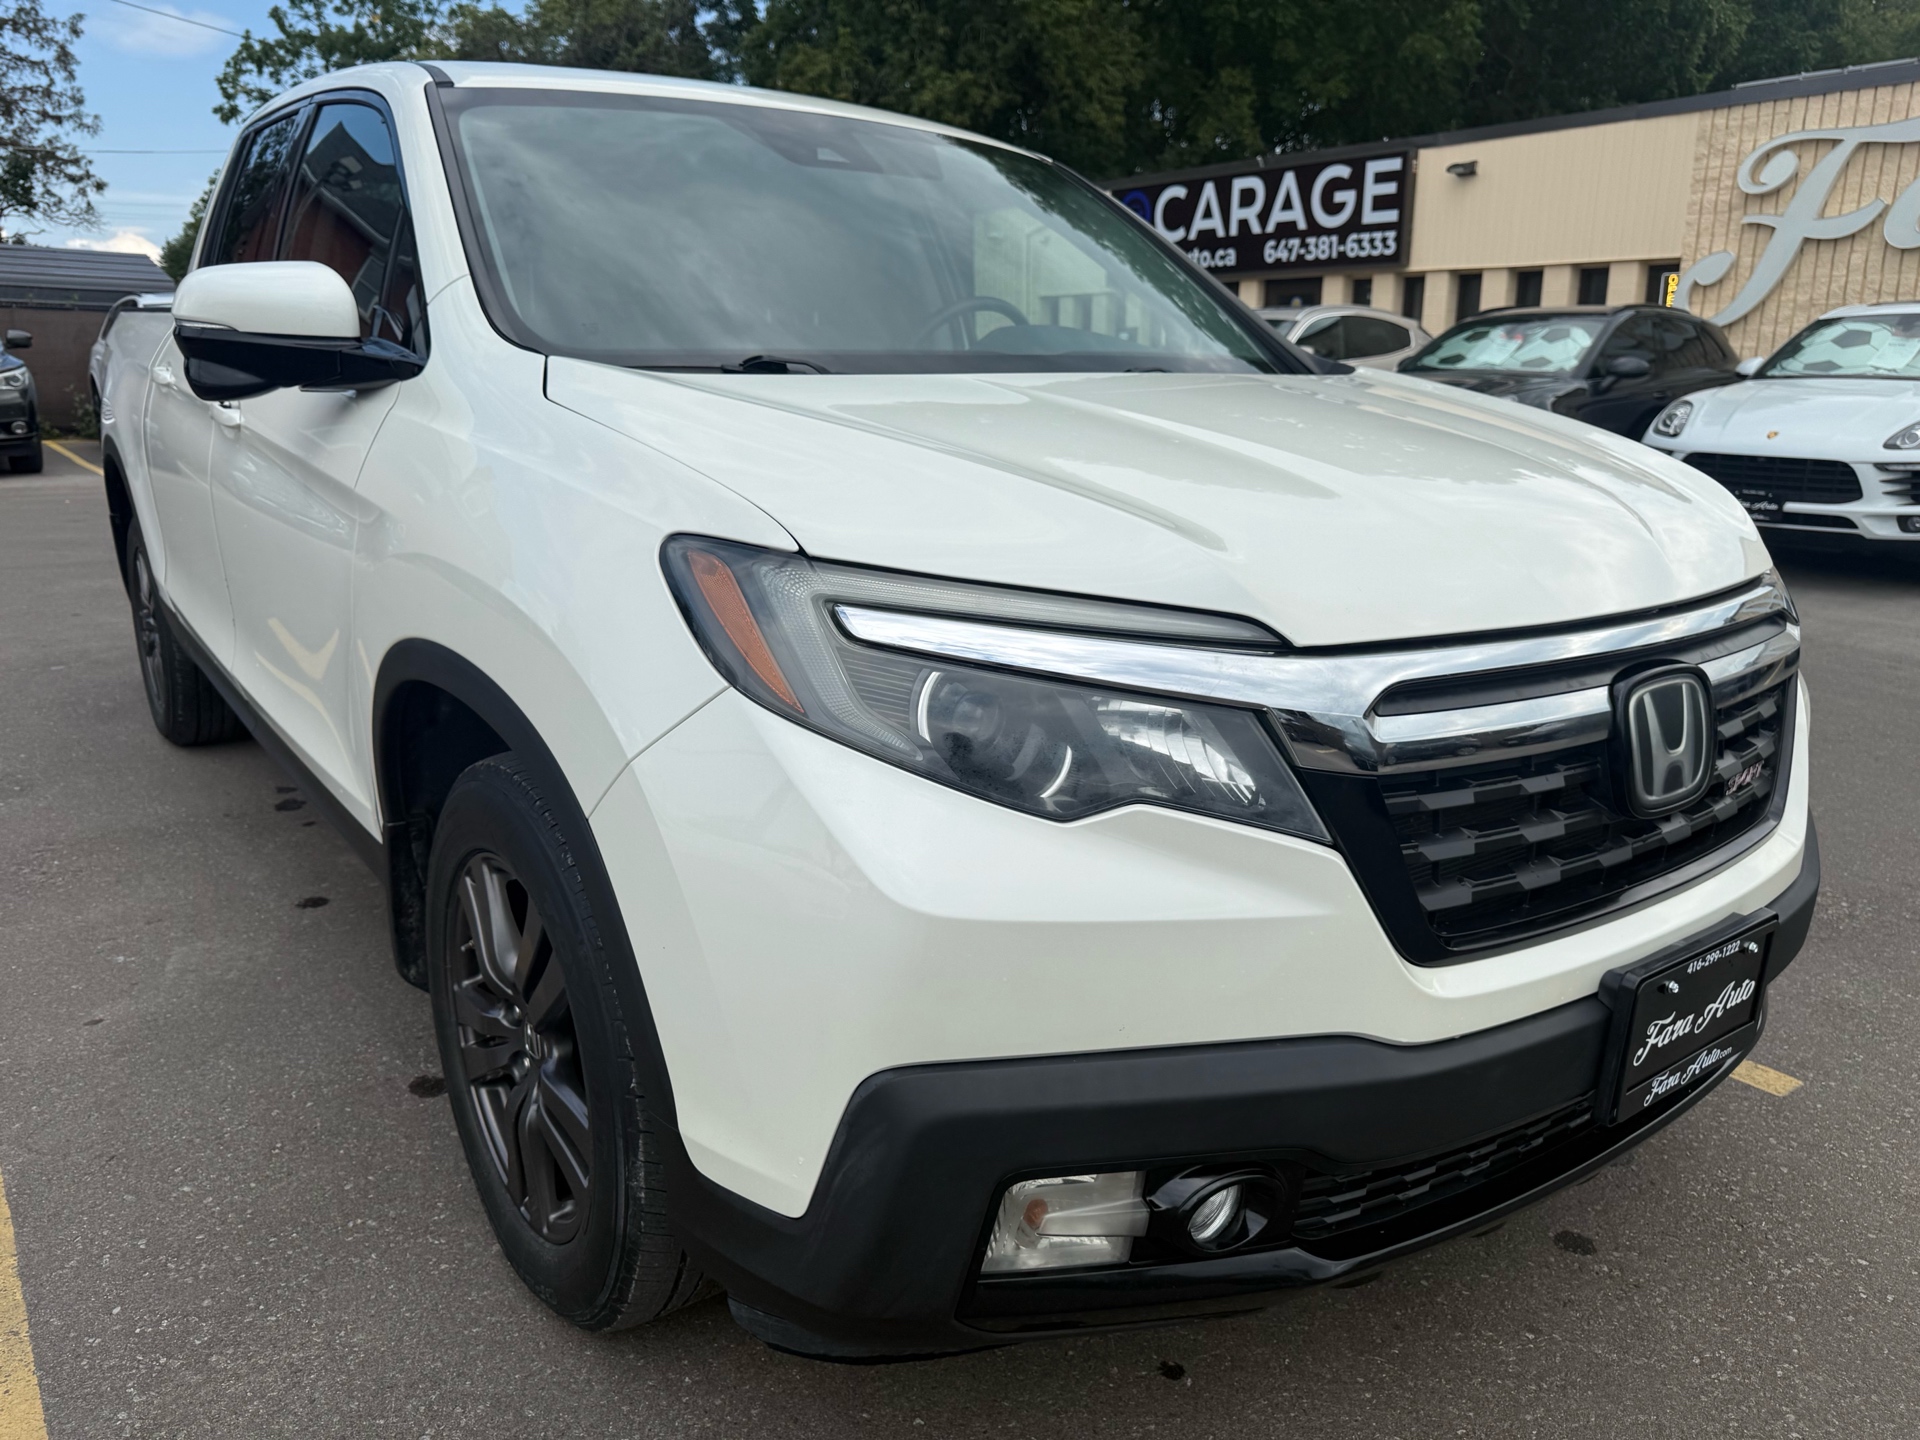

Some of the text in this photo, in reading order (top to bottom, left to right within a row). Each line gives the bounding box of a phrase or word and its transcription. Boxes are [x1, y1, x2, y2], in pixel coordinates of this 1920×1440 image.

[1263, 230, 1398, 264] 647-381-6333
[1687, 939, 1741, 974] 416-299-1222
[1694, 978, 1756, 1034] Auto
[1681, 1046, 1732, 1085] Auto.com
